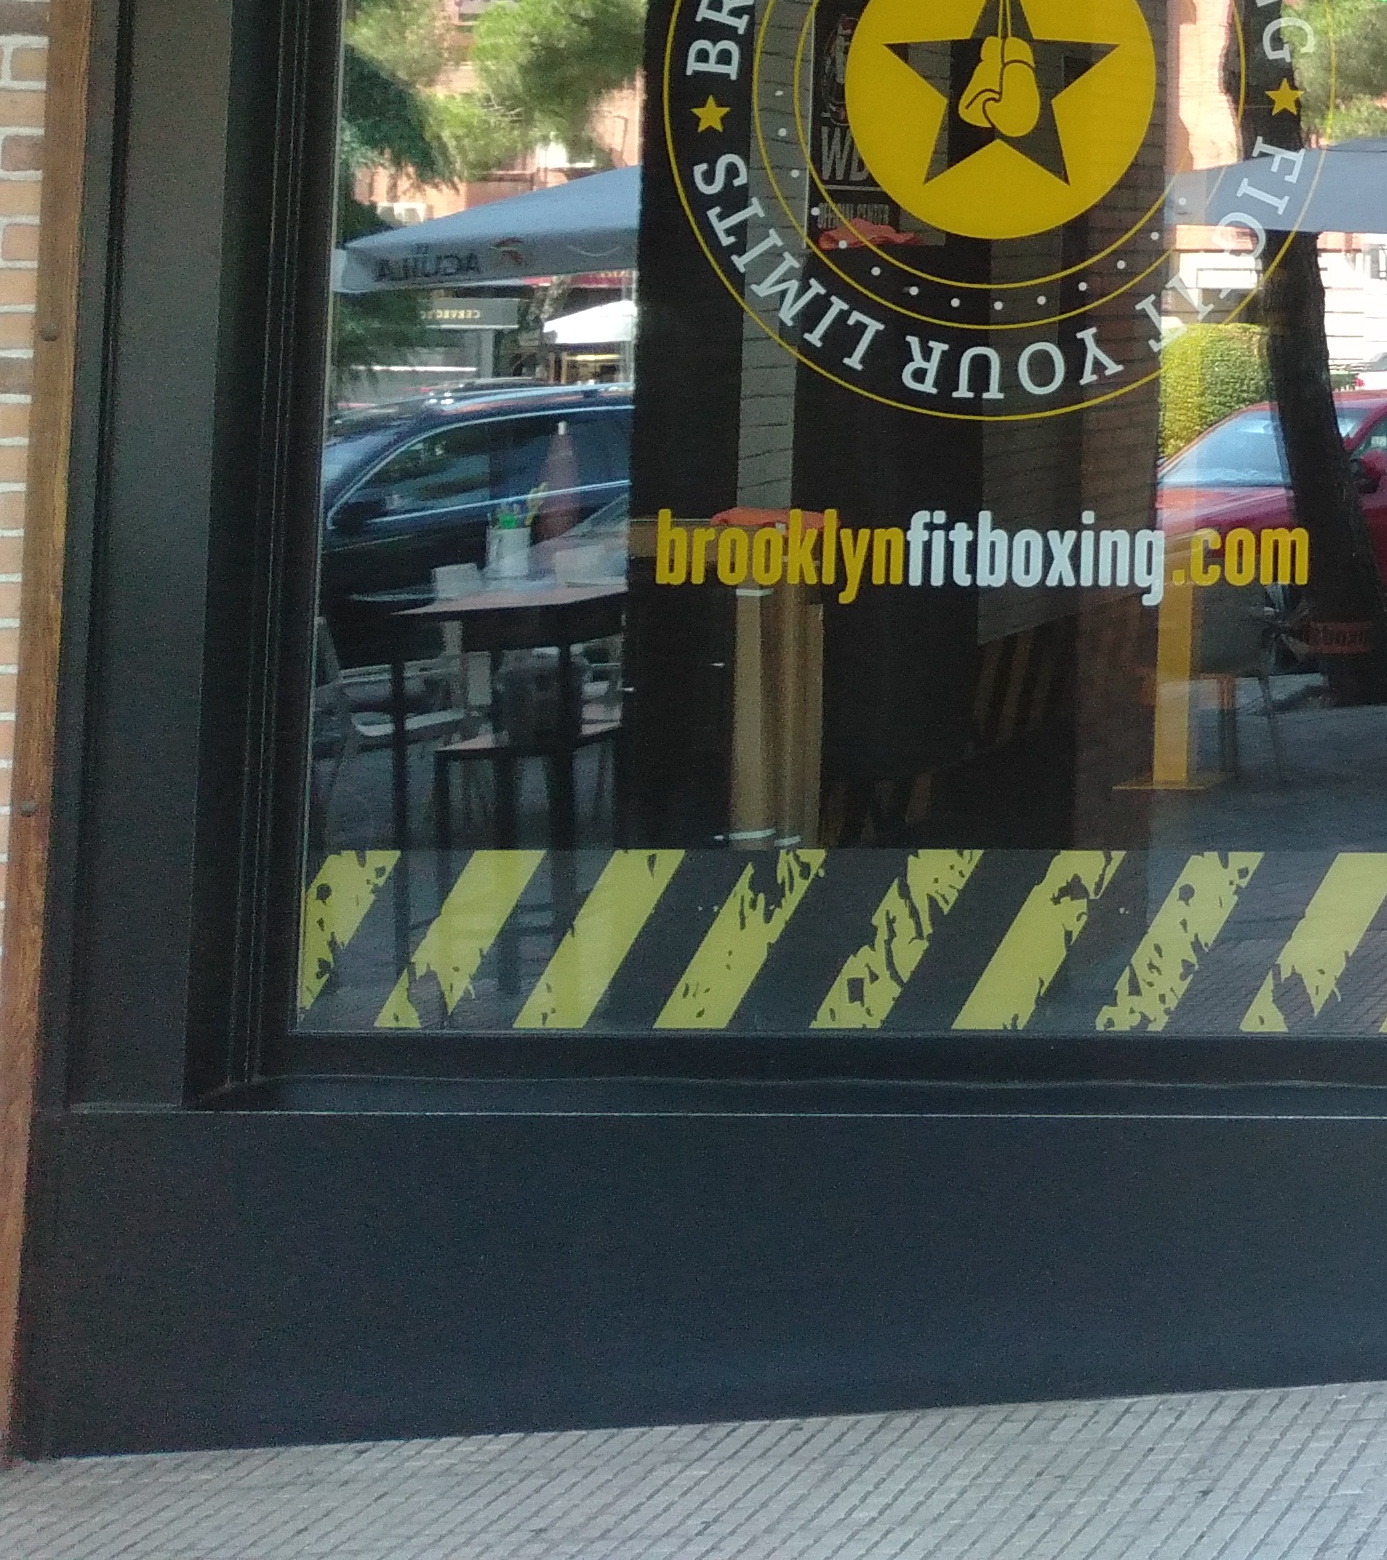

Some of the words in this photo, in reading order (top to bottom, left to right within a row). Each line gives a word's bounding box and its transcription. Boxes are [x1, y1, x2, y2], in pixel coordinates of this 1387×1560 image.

[692, 151, 885, 372] LIMITS
[901, 326, 1123, 400] YOUR
[655, 508, 1311, 607] brooklynfitboxing.com
